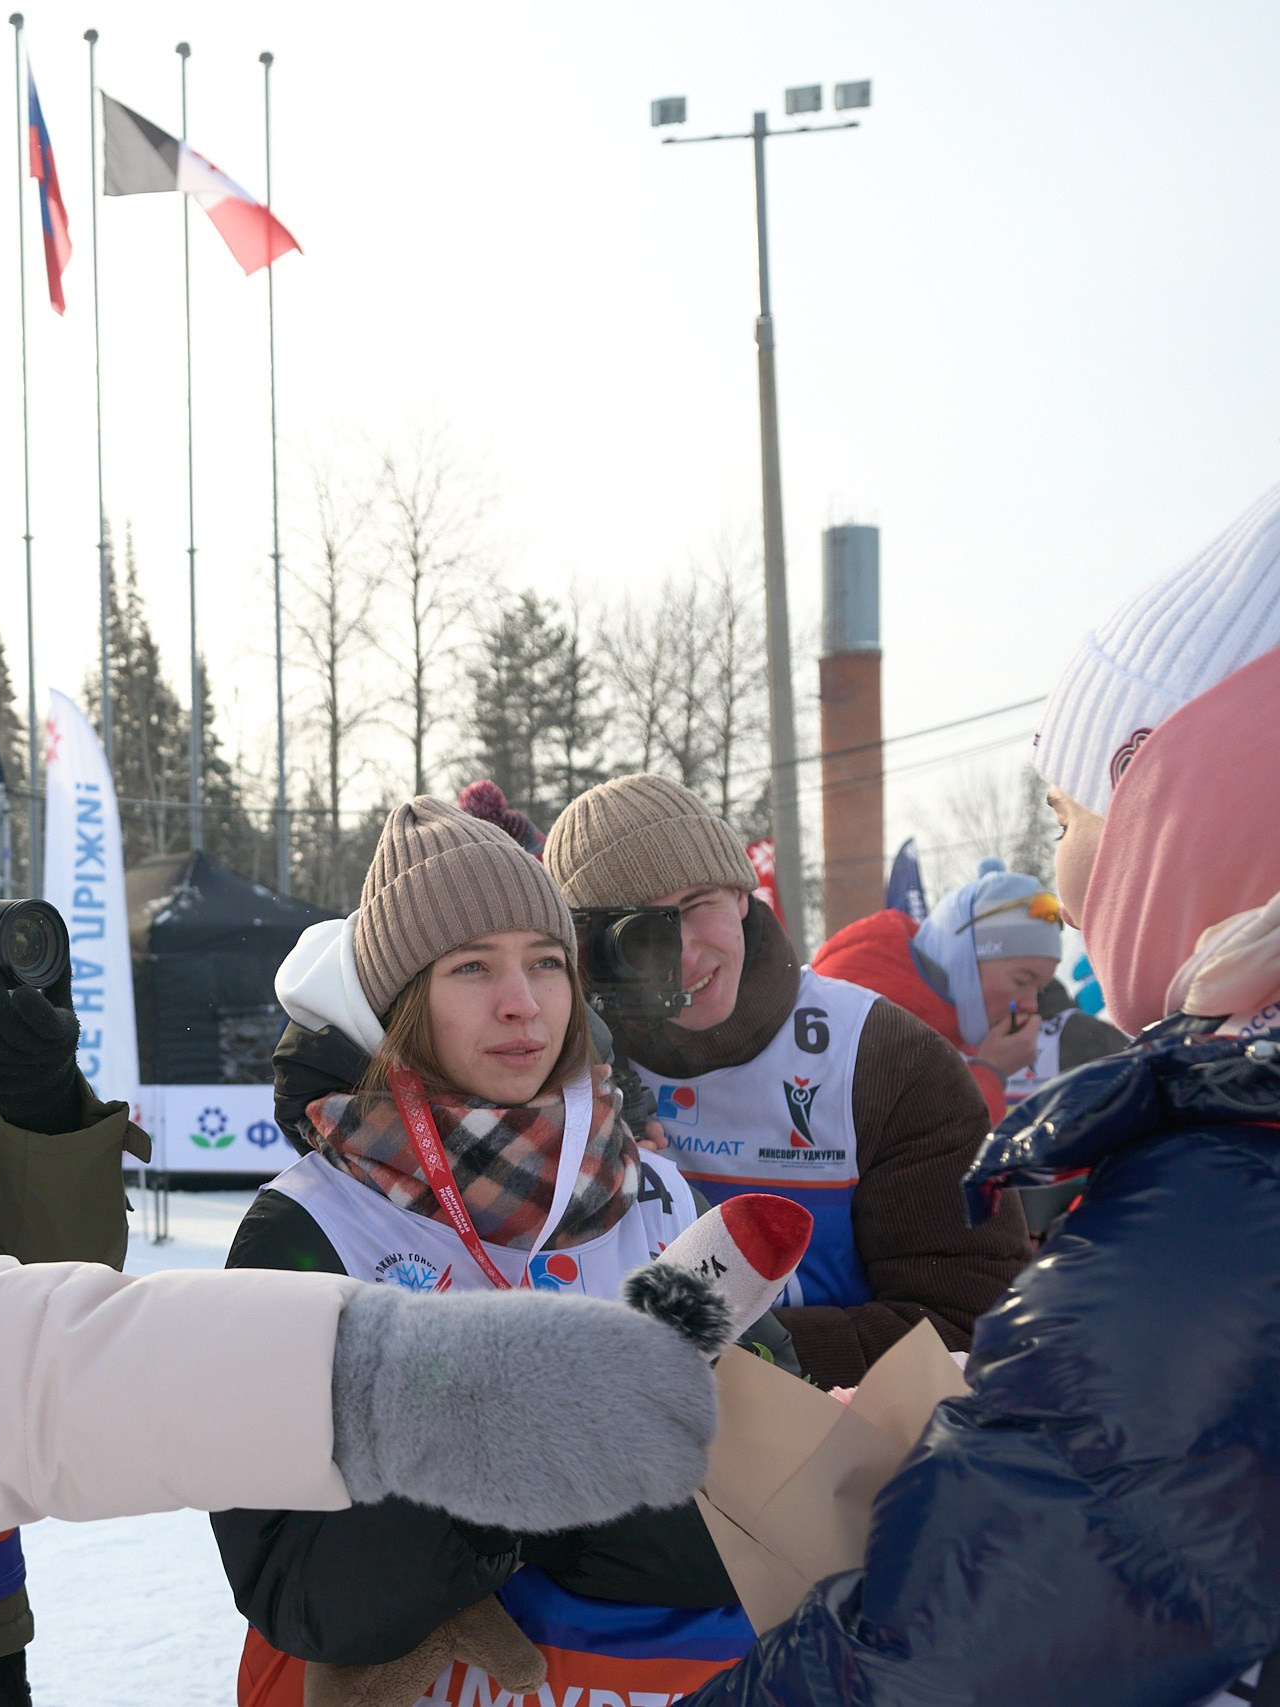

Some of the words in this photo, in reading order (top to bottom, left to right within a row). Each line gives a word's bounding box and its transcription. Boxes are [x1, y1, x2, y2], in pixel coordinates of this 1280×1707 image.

[794, 1006, 830, 1054] 6
[759, 1147, 801, 1160] МИНСПОРТ
[803, 1149, 846, 1161] УДМУРТИИ
[438, 1188, 465, 1235] РЕСПУБЛИКА
[445, 1184, 471, 1233] УДМУРТСКАЯ
[637, 1161, 674, 1215] 4
